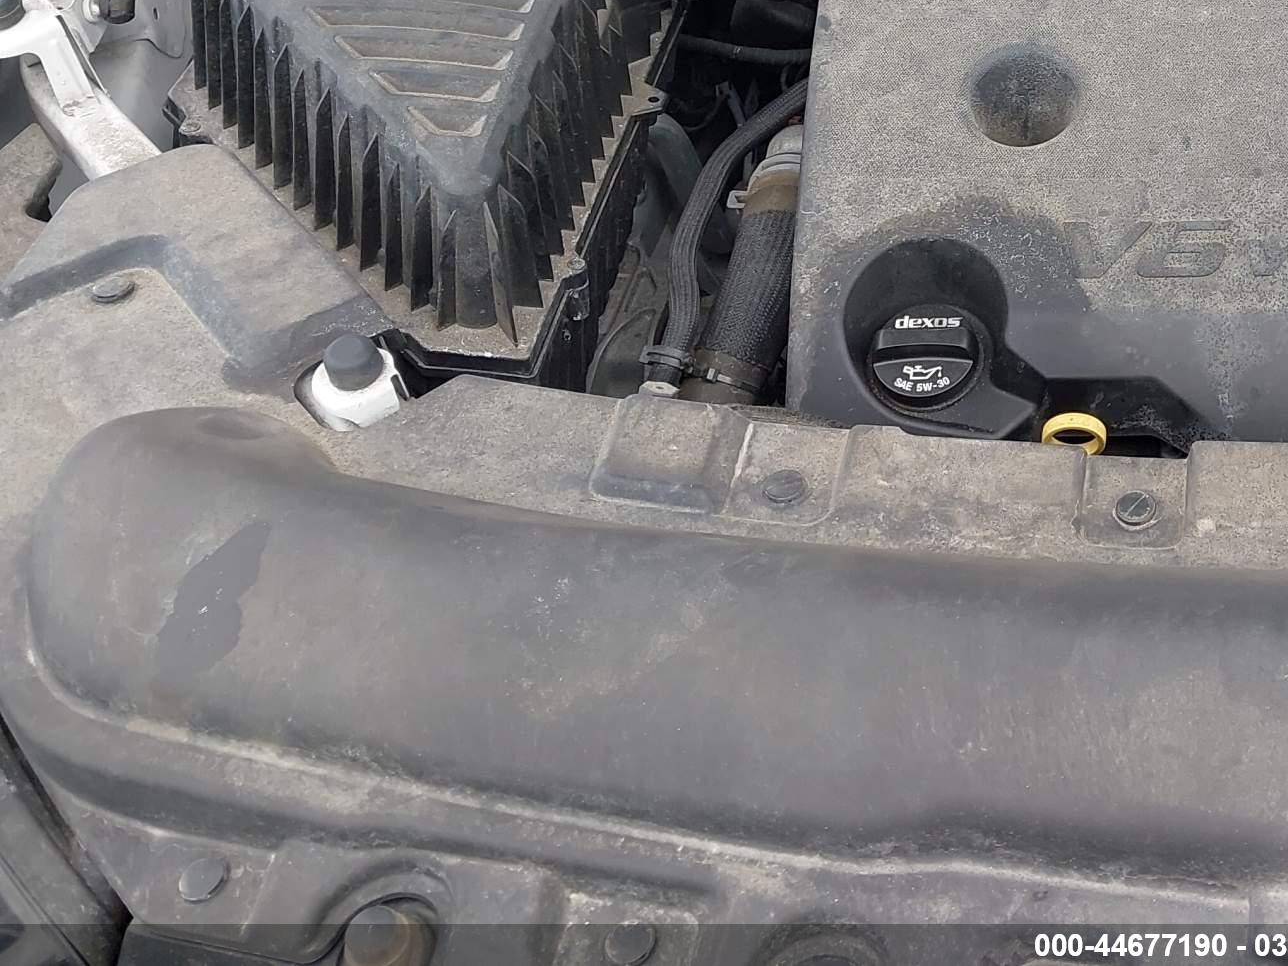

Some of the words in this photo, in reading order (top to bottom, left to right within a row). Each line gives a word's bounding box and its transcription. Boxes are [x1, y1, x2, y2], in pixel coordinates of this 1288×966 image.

[894, 315, 964, 329] dexos
[894, 377, 914, 392] SAE
[916, 376, 950, 392] 5W-30
